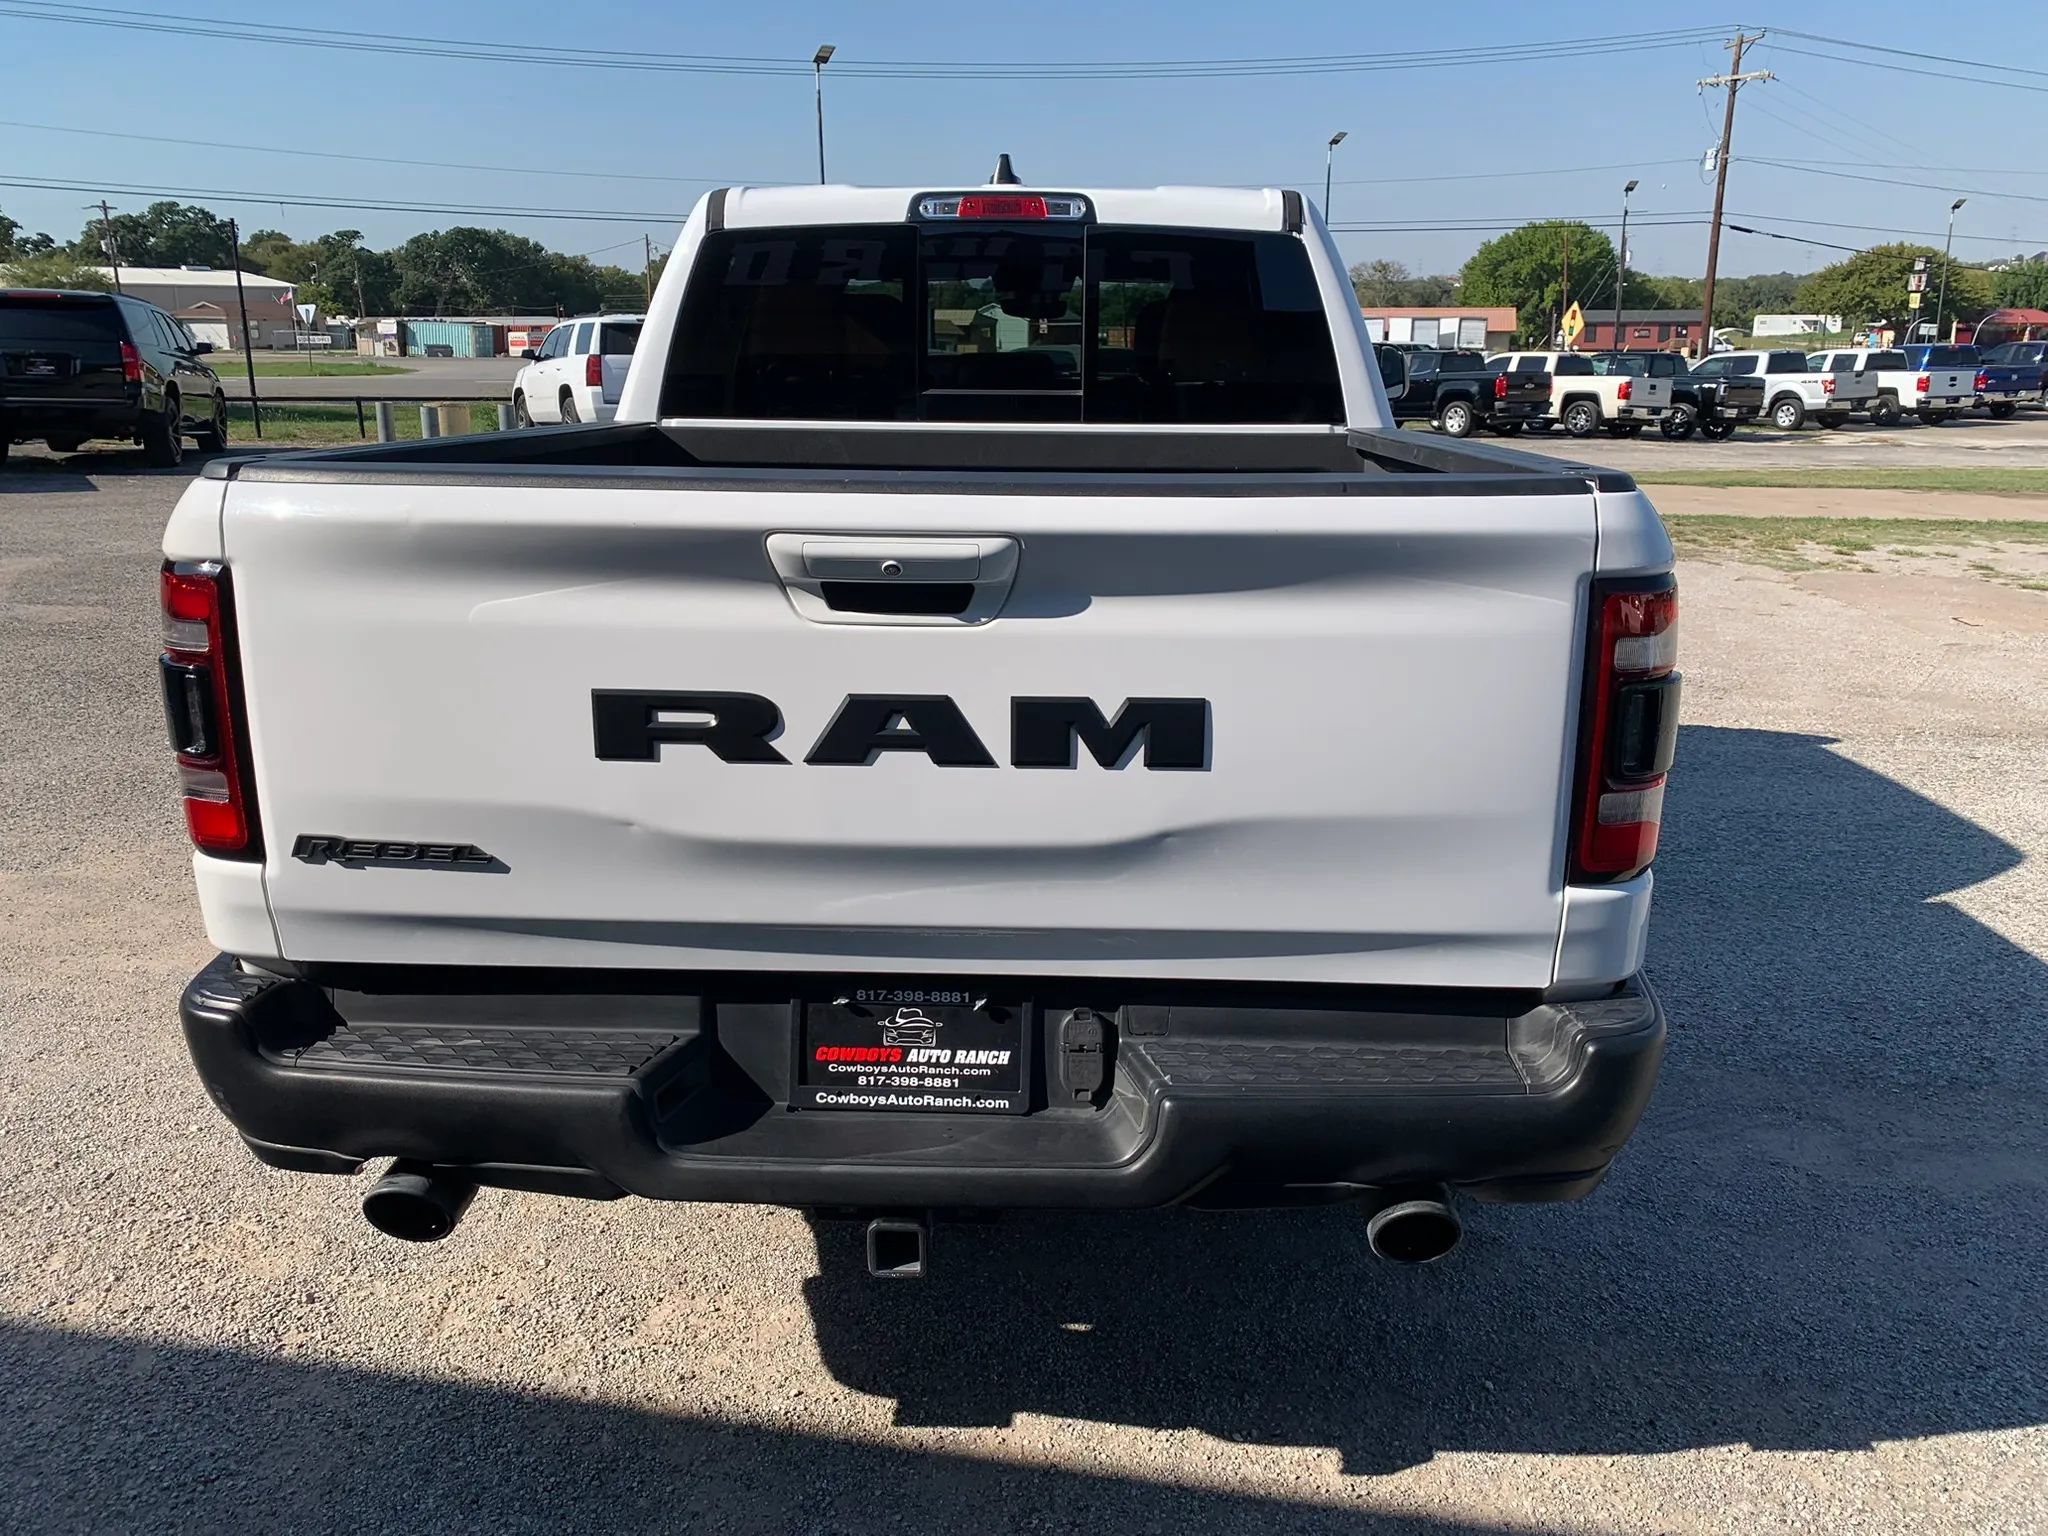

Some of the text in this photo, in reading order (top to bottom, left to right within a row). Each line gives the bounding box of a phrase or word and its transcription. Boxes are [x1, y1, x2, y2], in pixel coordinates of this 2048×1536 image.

[591, 688, 1211, 771] RAM
[292, 833, 508, 871] REBEL
[856, 989, 970, 1003] 817-398-8881
[815, 1046, 1011, 1065] COWBOYS AUTO RANCH
[828, 1063, 991, 1076] CowboysAutoRanch.com
[858, 1076, 959, 1088] 817-398-8881
[815, 1092, 1009, 1109] CowboysAutoRanch.com
